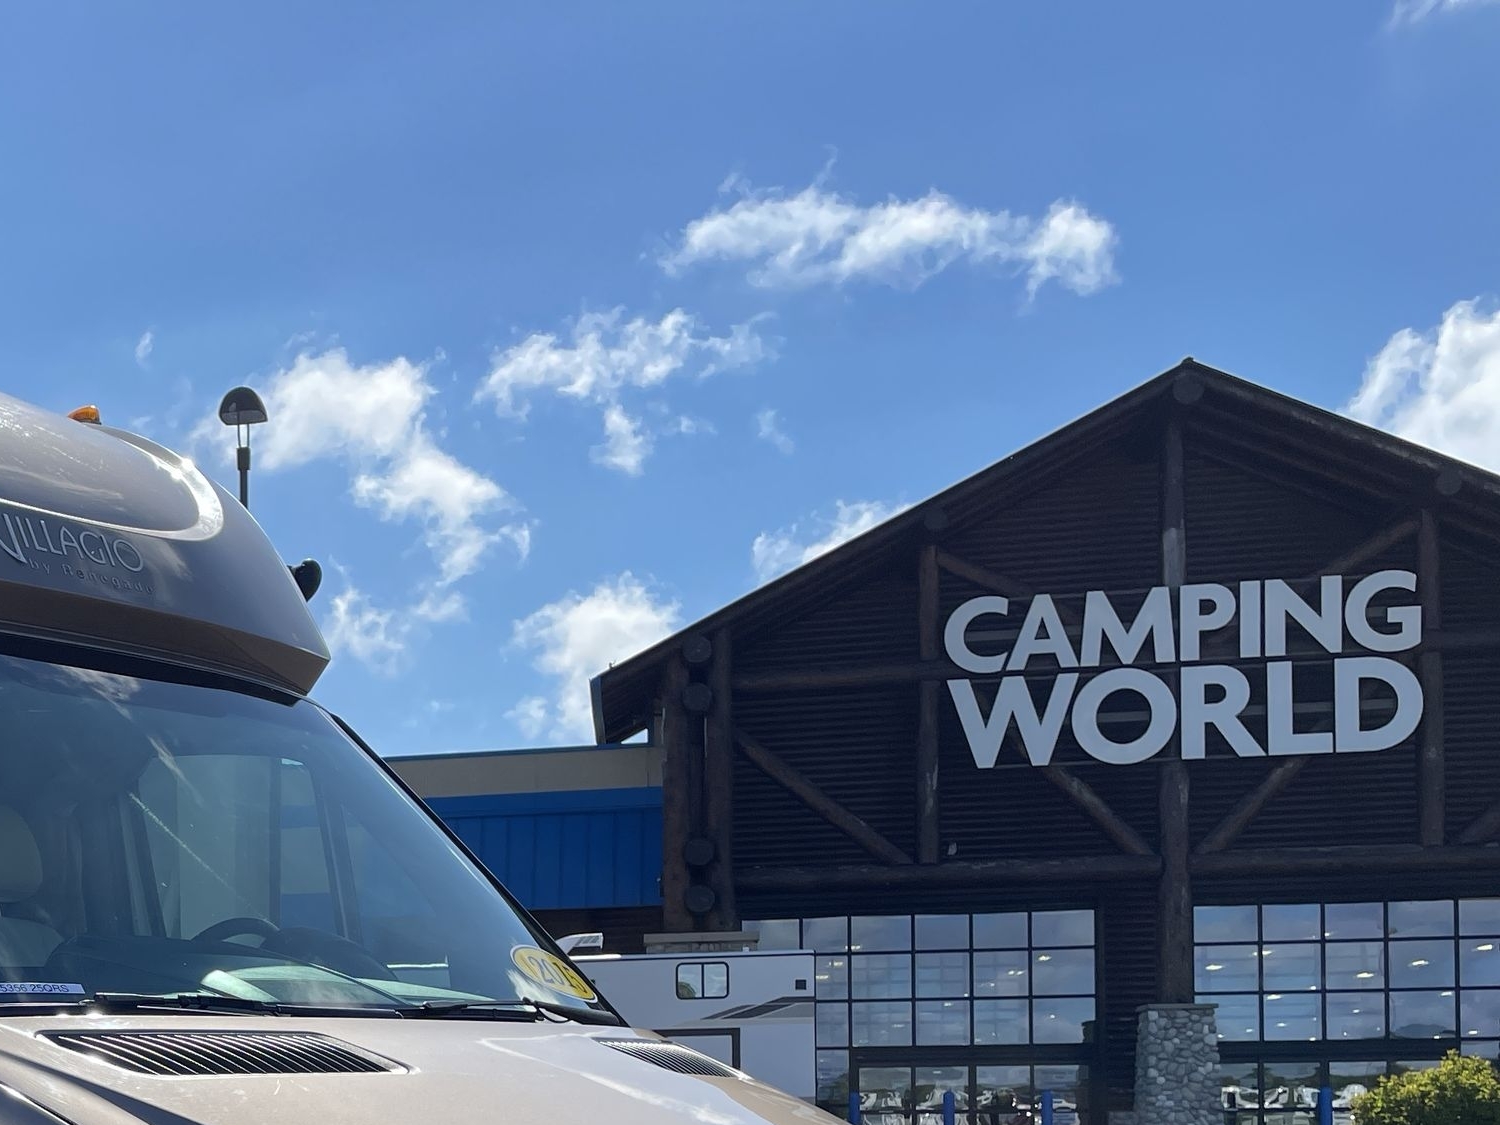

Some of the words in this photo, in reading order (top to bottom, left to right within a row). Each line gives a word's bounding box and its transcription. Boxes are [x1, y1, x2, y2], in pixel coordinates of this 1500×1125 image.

[944, 569, 1422, 673] CAMPING
[947, 656, 1424, 769] WORLD
[528, 956, 588, 994] 2015
